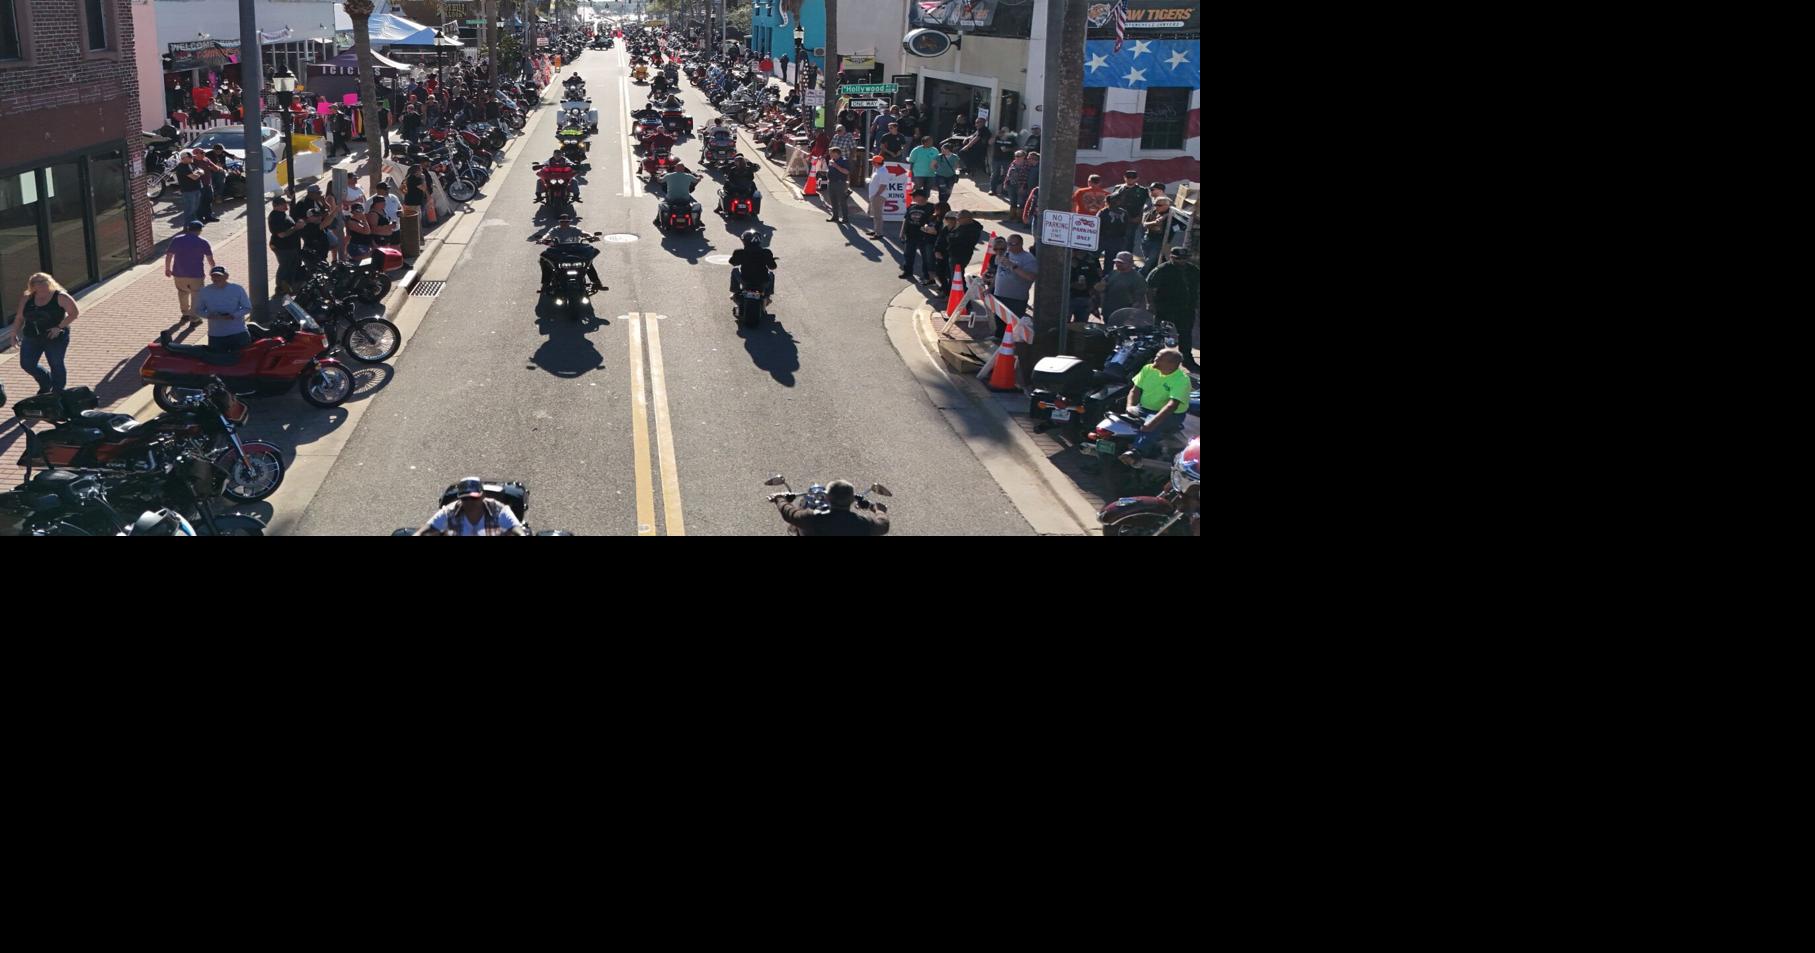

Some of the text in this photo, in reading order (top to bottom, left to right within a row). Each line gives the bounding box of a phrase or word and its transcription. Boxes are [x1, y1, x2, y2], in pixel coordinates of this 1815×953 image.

[1126, 8, 1192, 20] AW TIGERS
[171, 41, 215, 50] WELCOME
[322, 66, 381, 75] ICICS
[1045, 221, 1069, 229] PARKING
